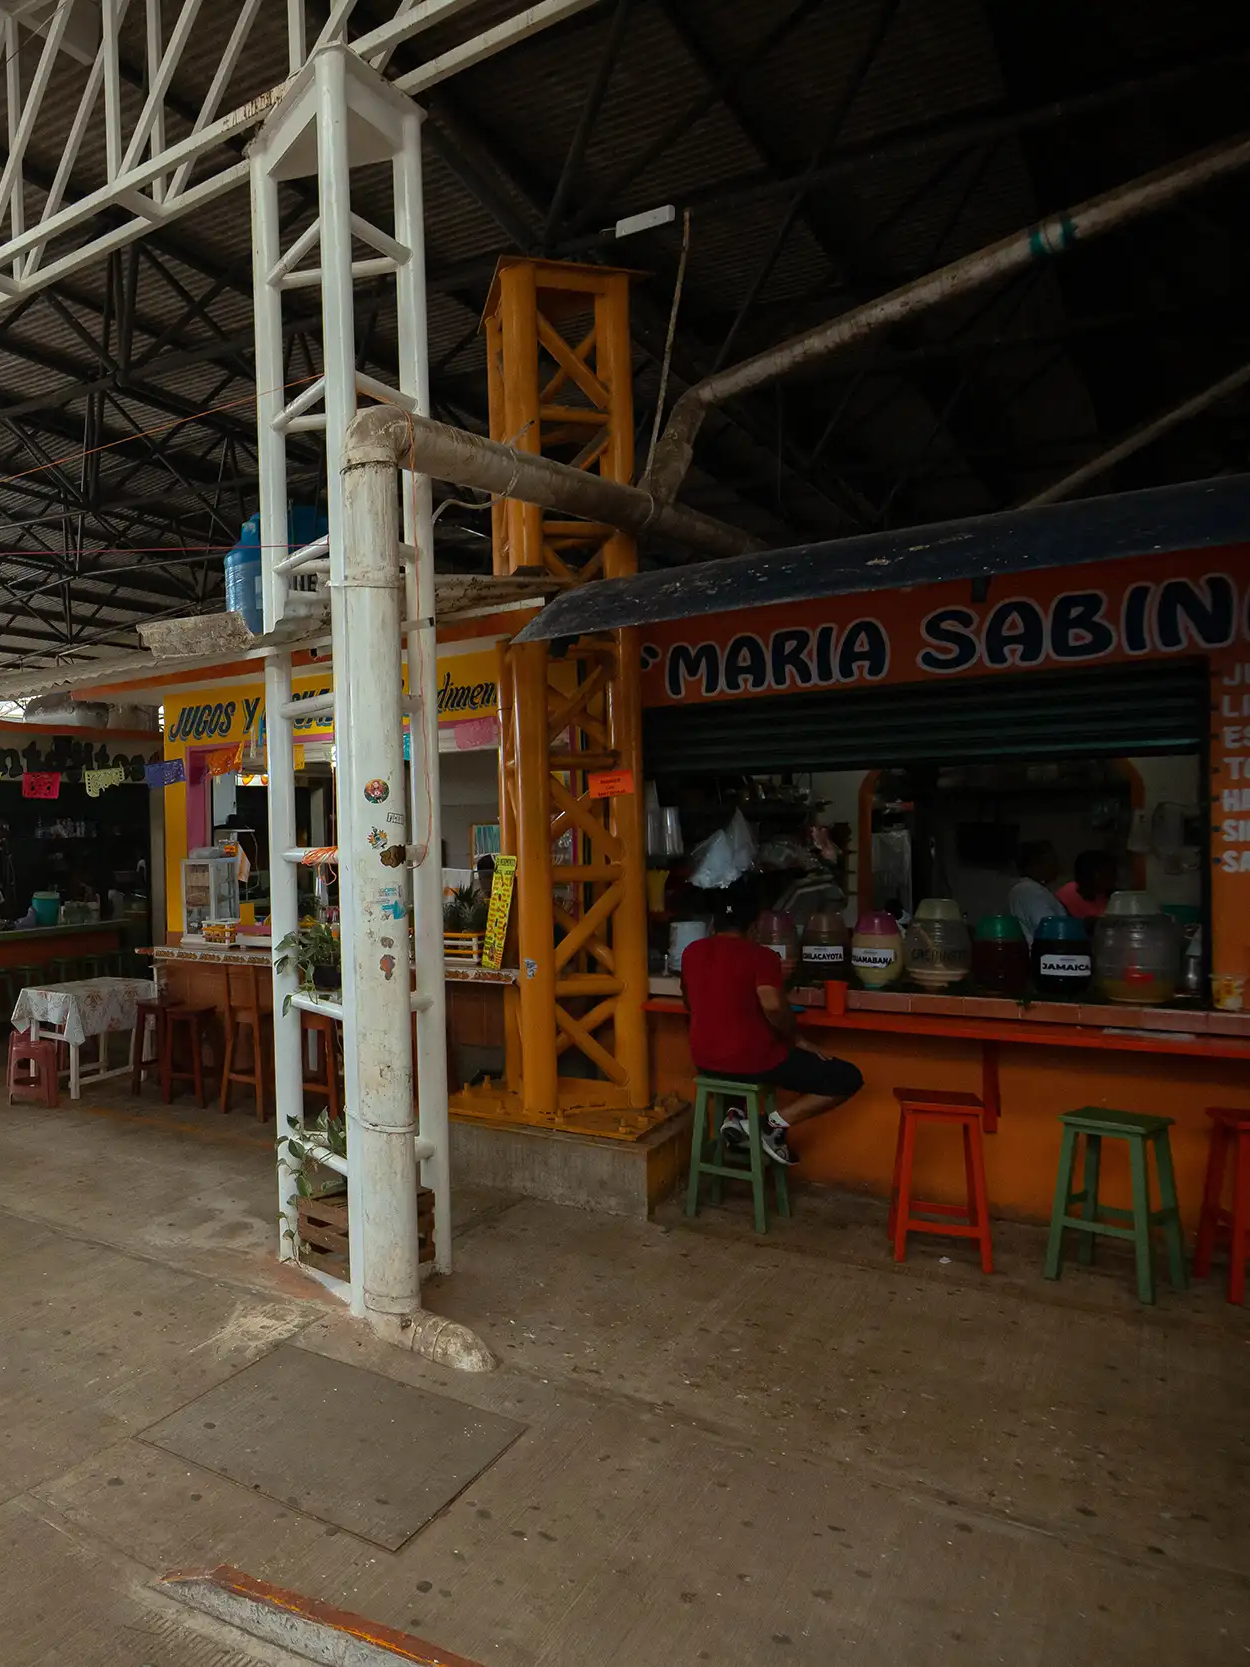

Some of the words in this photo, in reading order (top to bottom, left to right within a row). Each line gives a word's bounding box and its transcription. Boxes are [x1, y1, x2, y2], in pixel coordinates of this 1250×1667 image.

[916, 573, 1250, 673] SABIN
[168, 701, 236, 742] JUGOS
[241, 697, 261, 734] Y
[1042, 962, 1091, 971] JAMAICA
